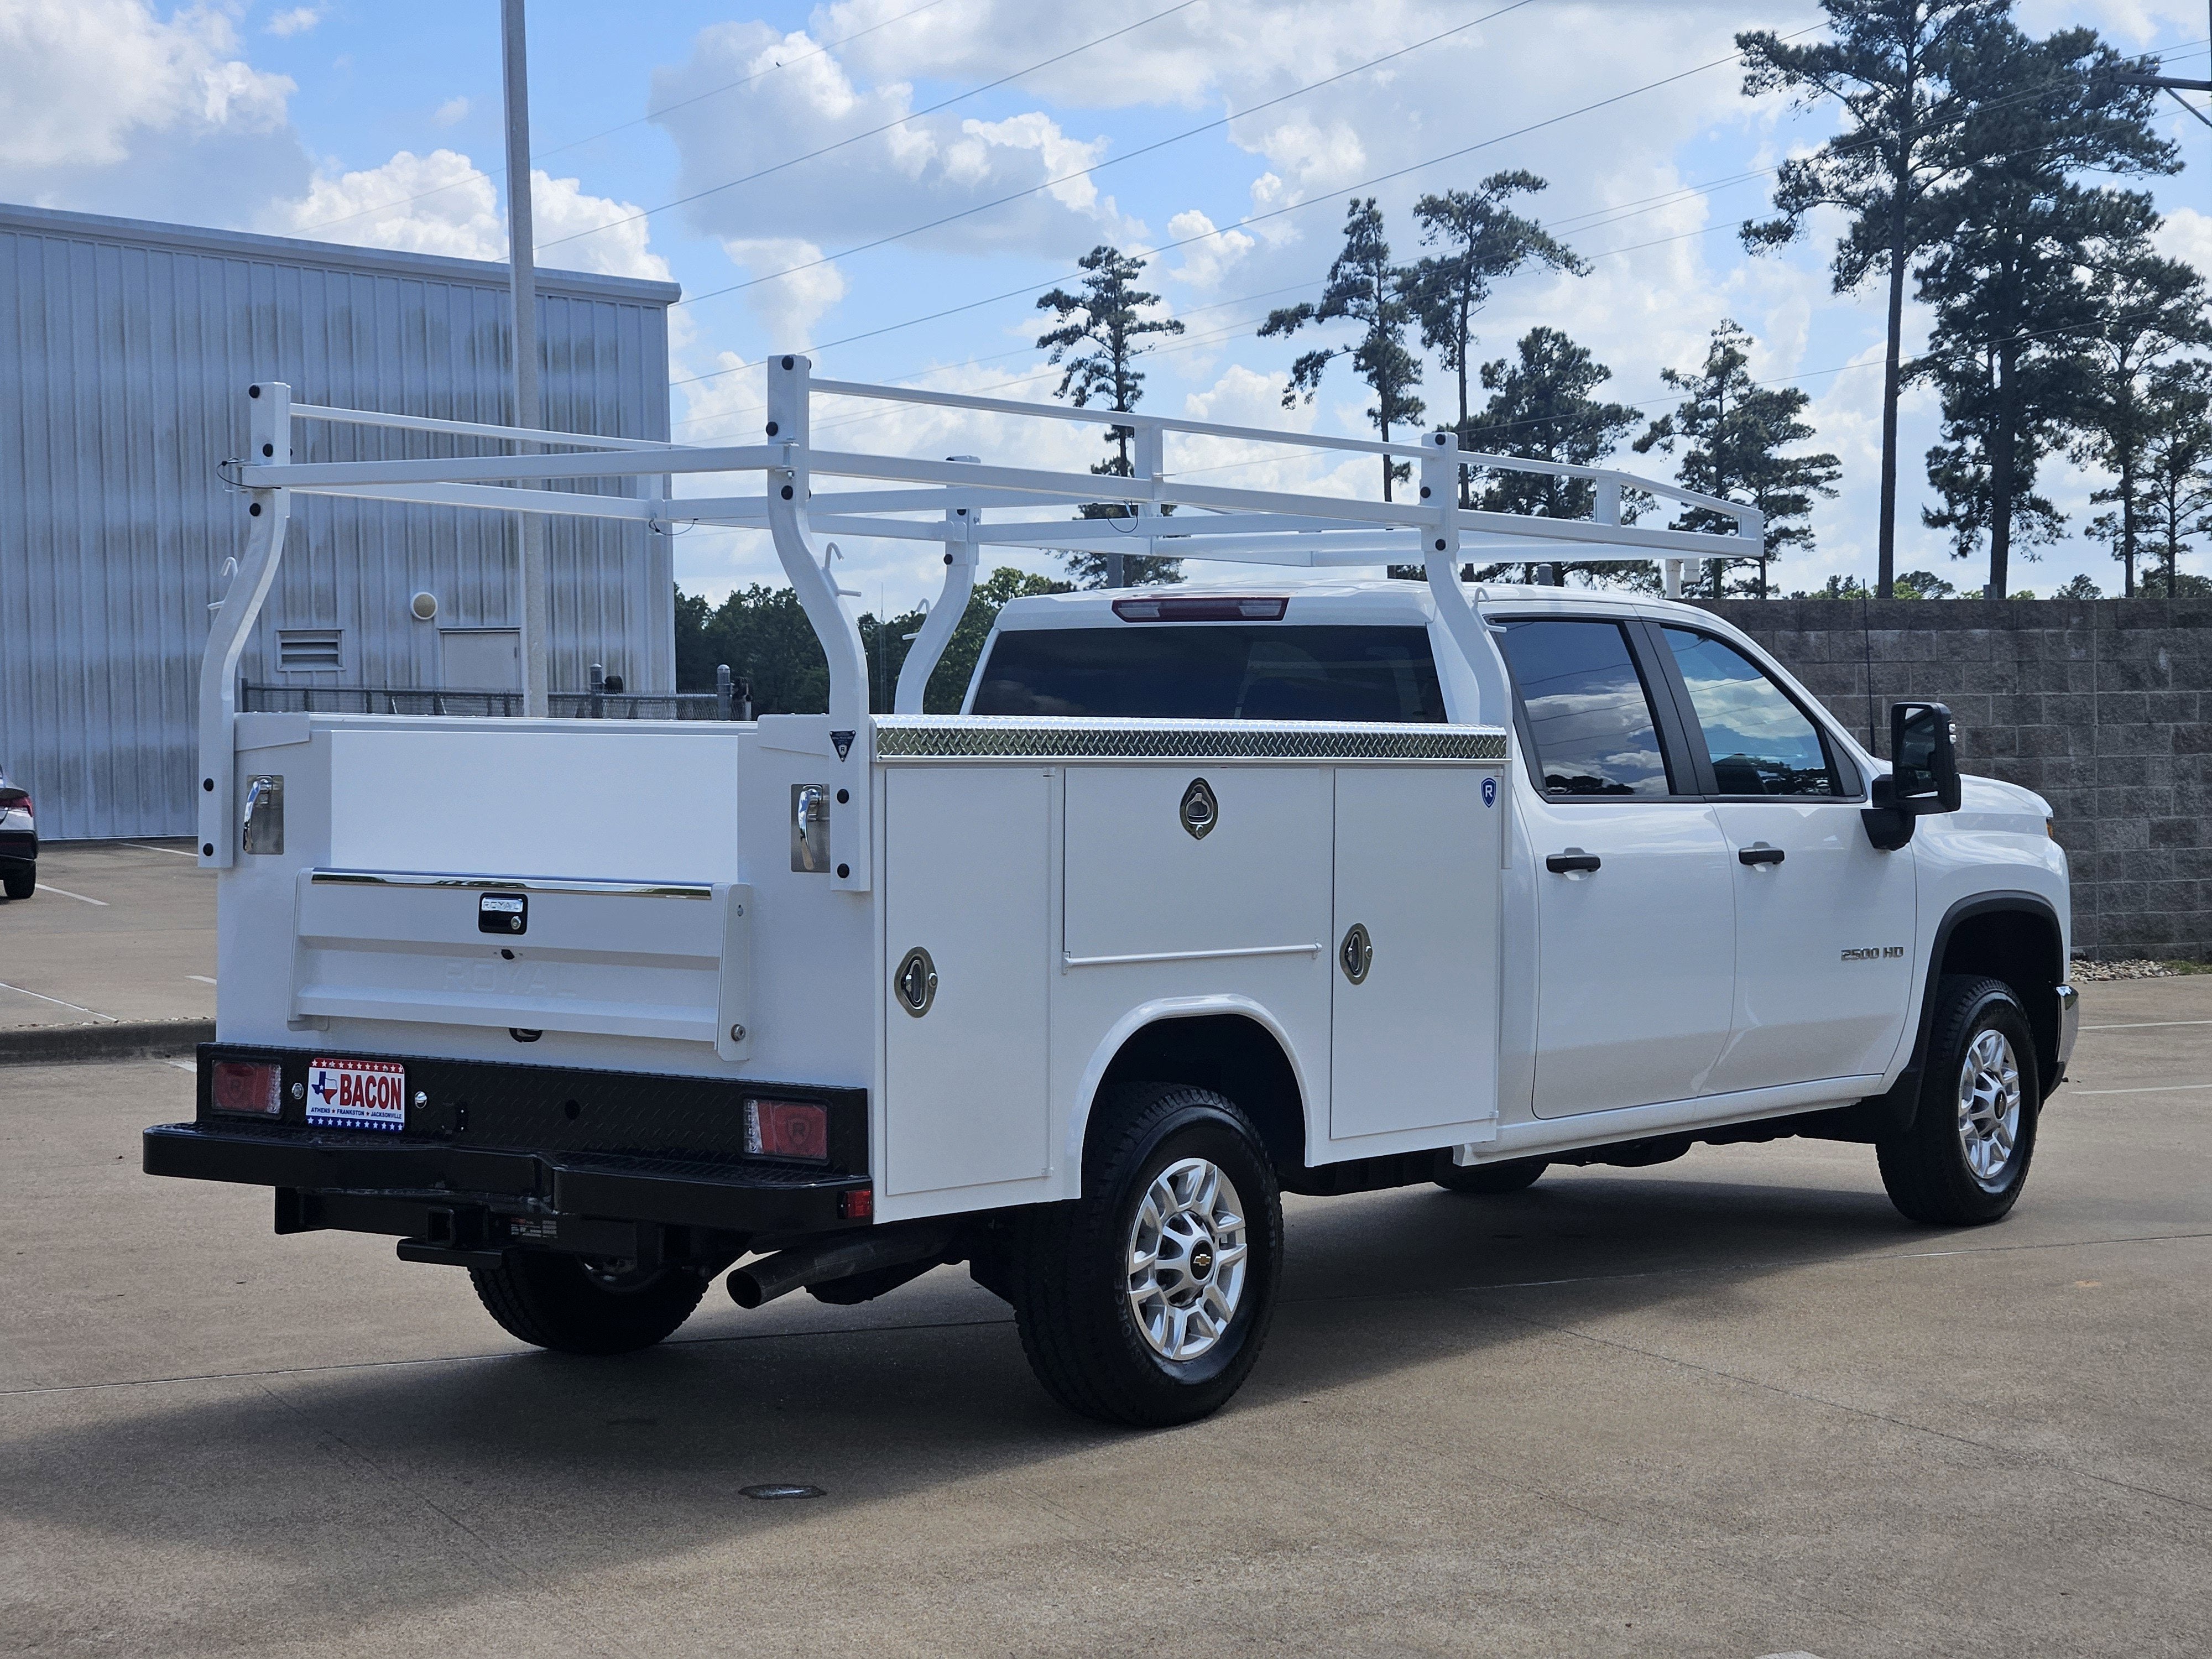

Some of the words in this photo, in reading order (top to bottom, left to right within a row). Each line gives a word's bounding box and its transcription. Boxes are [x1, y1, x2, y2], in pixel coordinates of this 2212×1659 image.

[1485, 785, 1493, 797] R
[1840, 947, 1880, 961] 2500
[1883, 946, 1903, 958] HD
[339, 1074, 401, 1110] BACON
